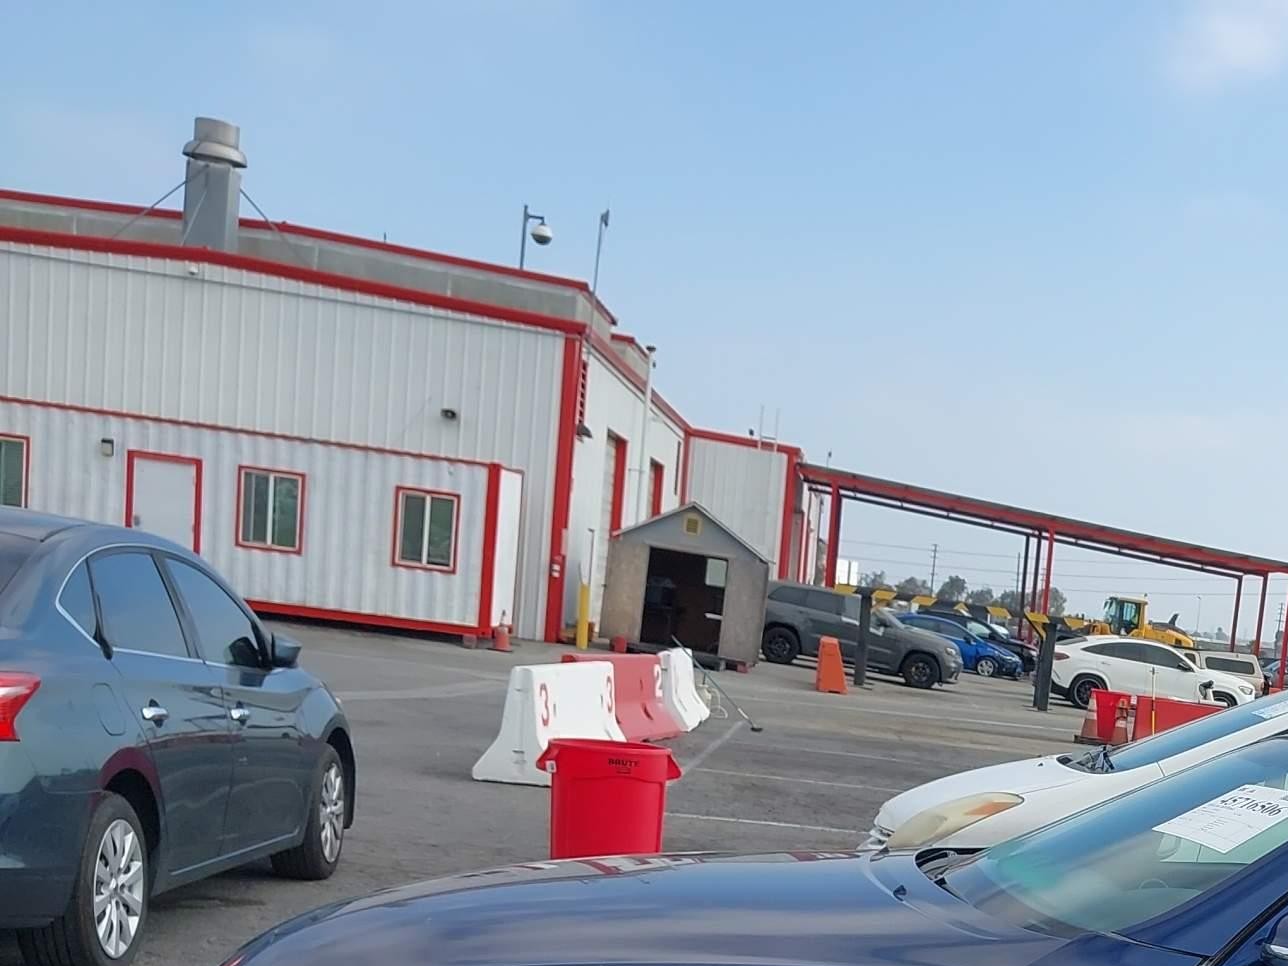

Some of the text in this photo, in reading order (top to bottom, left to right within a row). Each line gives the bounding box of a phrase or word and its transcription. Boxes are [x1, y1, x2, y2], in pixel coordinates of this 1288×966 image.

[605, 675, 614, 714] 3
[653, 664, 663, 698] 2
[540, 682, 551, 727] 3
[1219, 795, 1288, 816] 45716506
